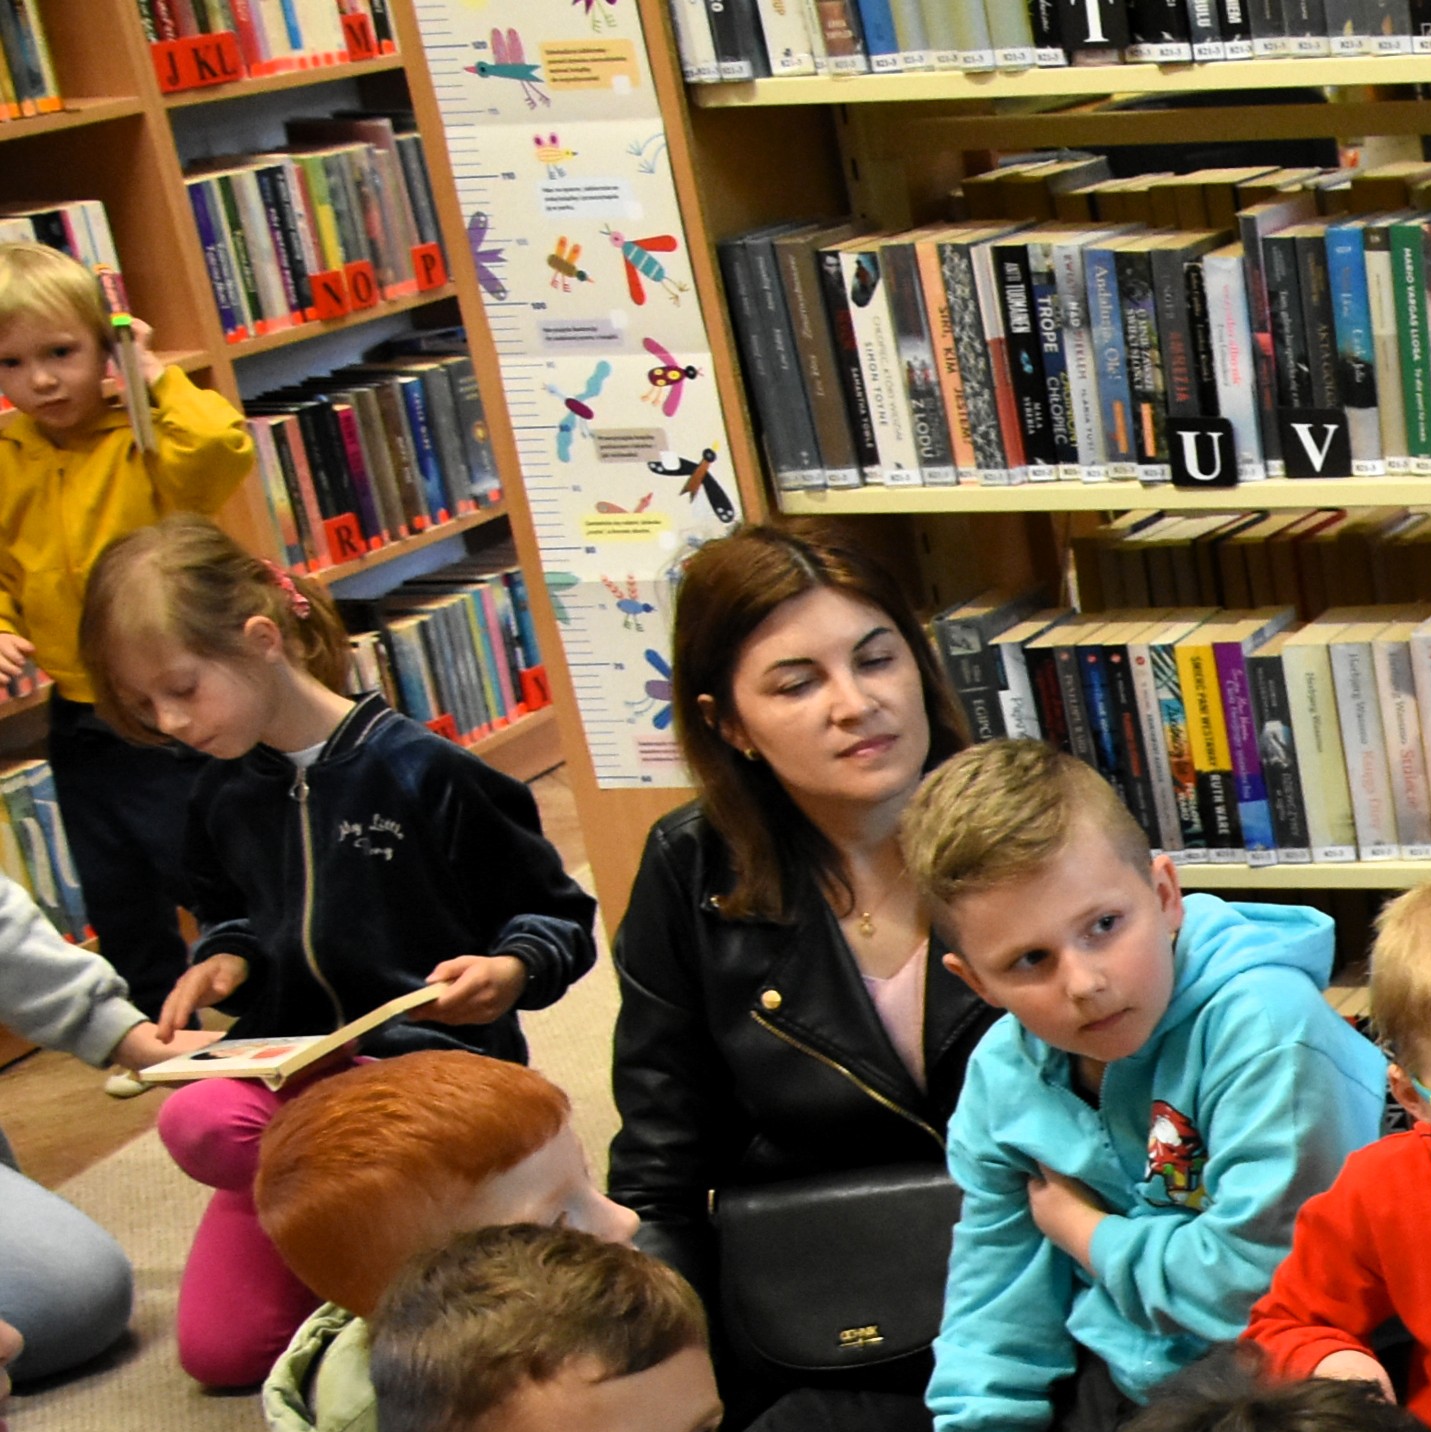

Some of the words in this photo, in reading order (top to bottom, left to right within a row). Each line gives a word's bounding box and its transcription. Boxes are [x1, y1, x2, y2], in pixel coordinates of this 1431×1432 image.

[166, 51, 180, 86] J
[192, 42, 240, 80] KL
[420, 253, 437, 286] P
[1404, 248, 1415, 283] MARIO
[352, 270, 373, 304] O
[1406, 286, 1418, 326] VARGAS
[1037, 296, 1059, 354] TROPE
[1410, 328, 1420, 361] LLOSA
[864, 341, 878, 380] SIMON
[874, 387, 888, 427] TOYNE
[1177, 431, 1224, 481] U
[1291, 423, 1339, 473] V
[333, 523, 363, 557] R
[1210, 774, 1224, 803] RUTH
[1216, 805, 1229, 835] WARE
